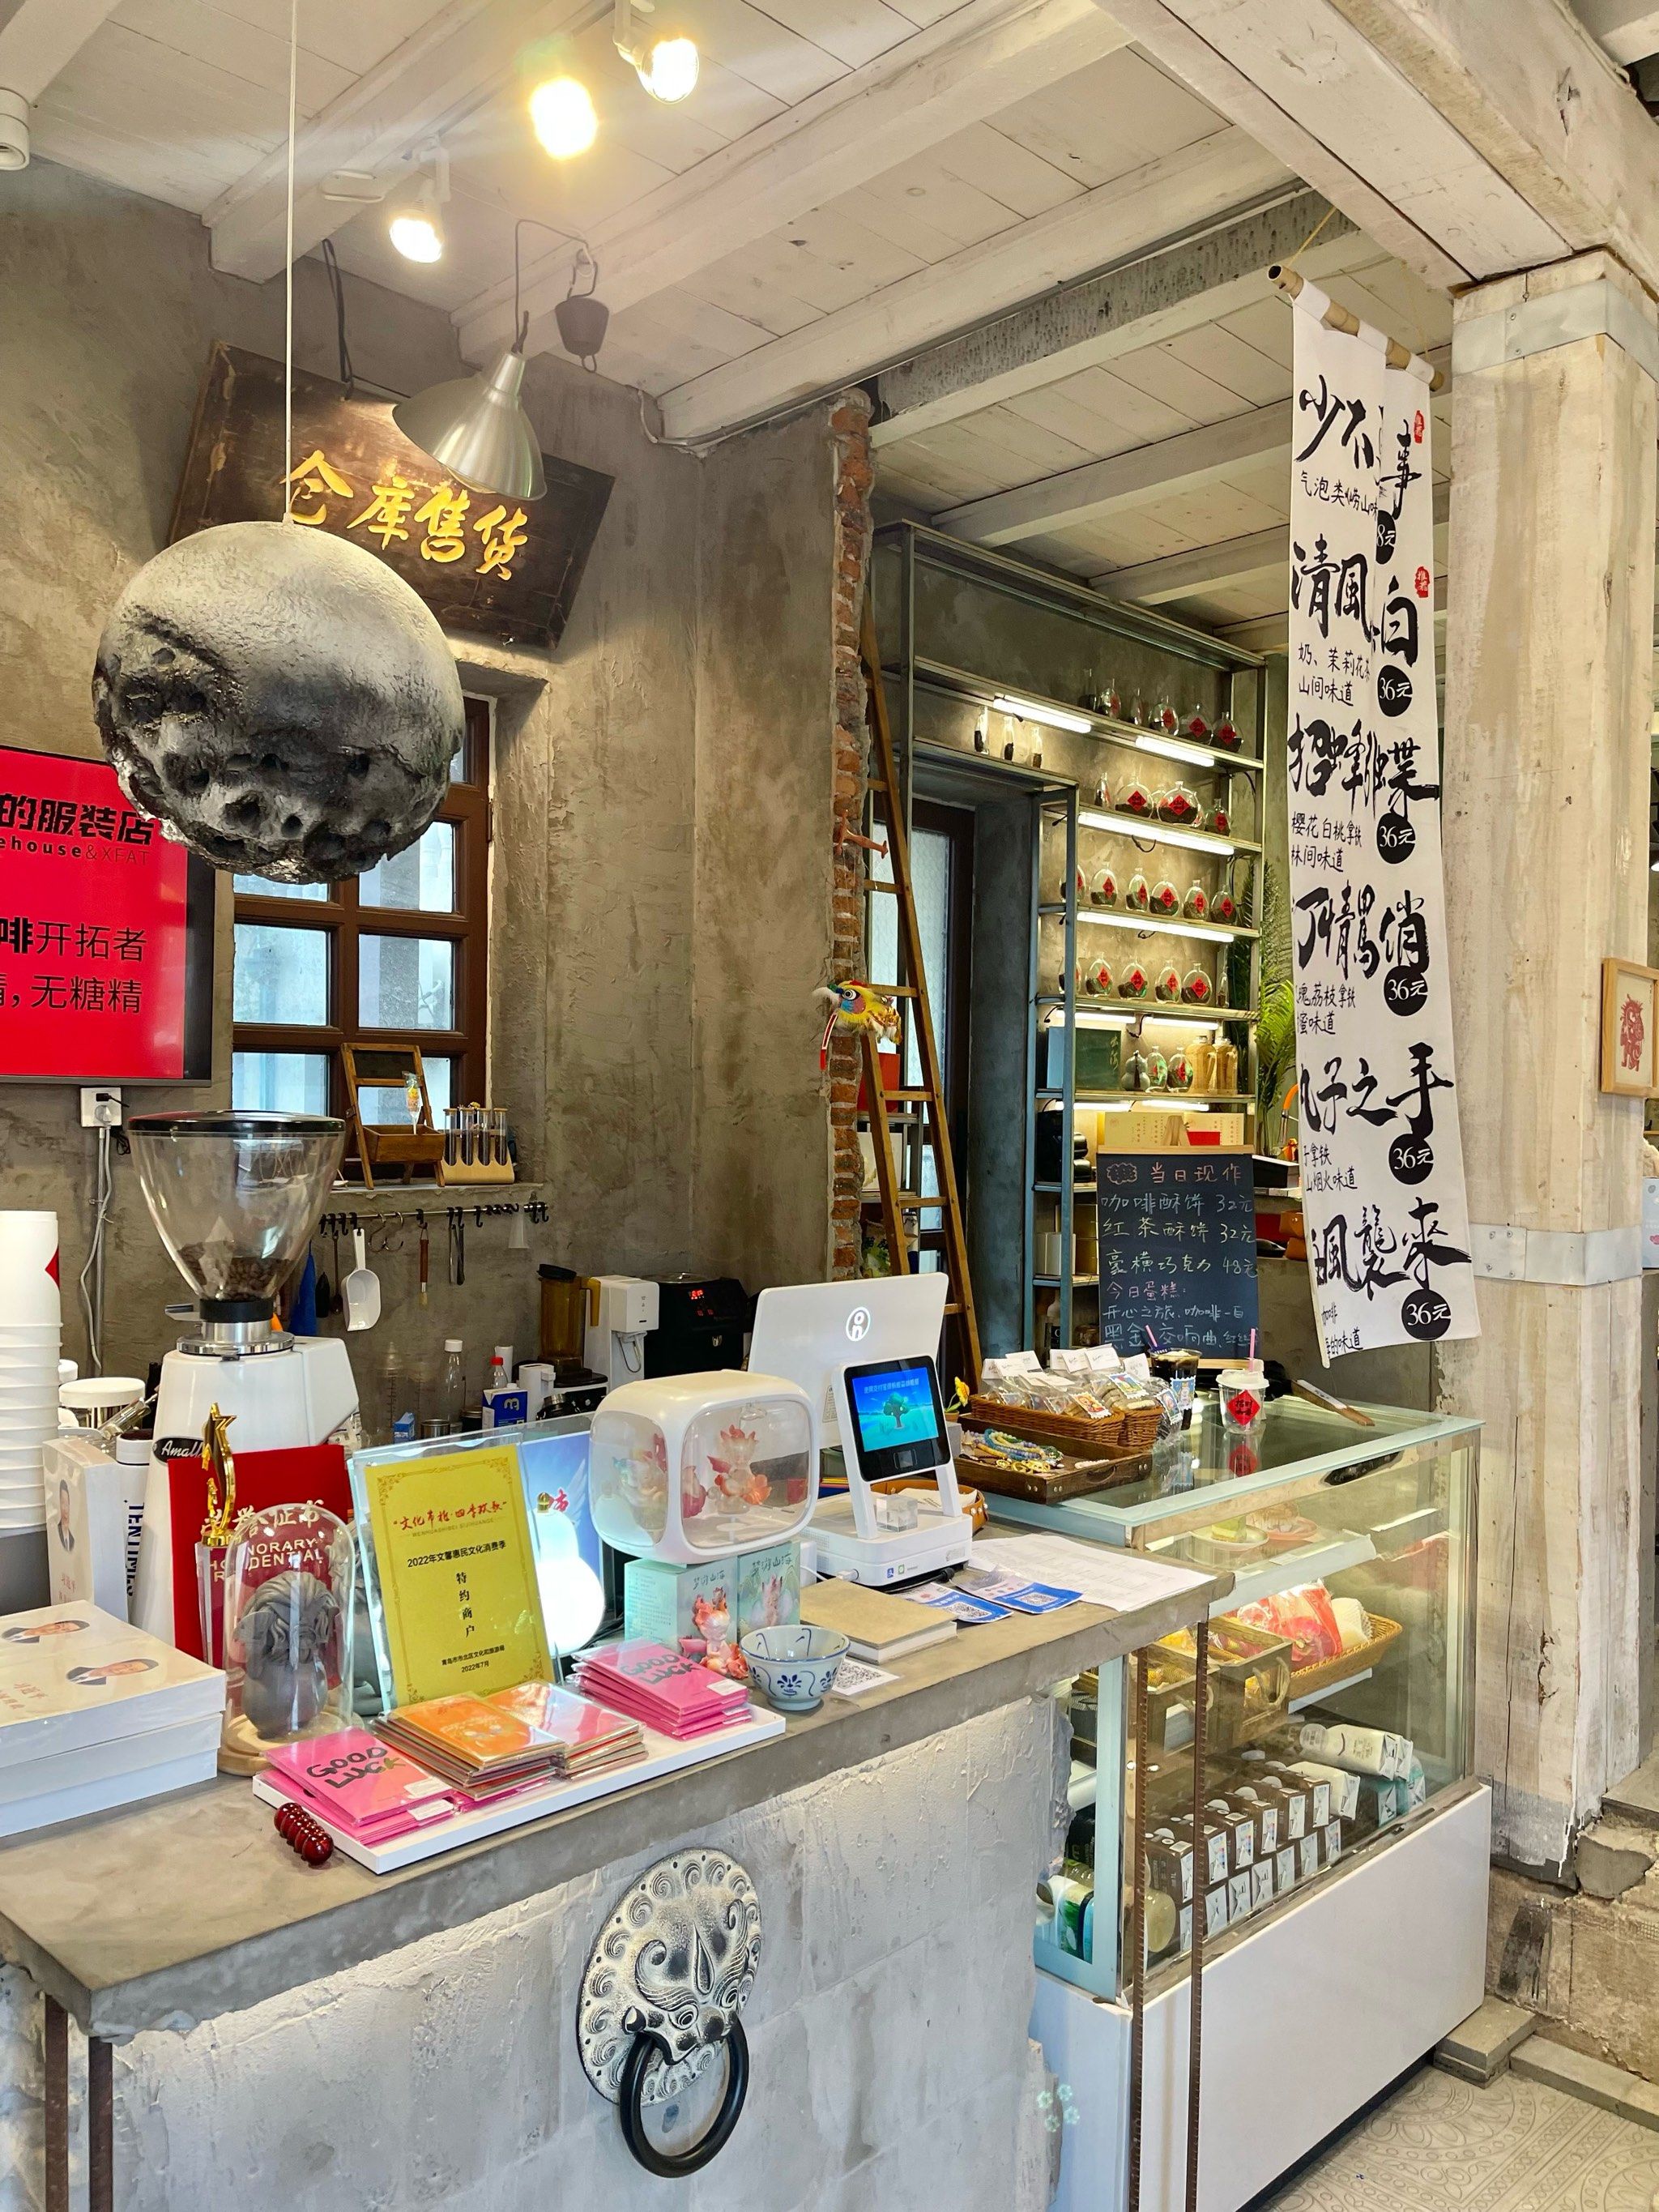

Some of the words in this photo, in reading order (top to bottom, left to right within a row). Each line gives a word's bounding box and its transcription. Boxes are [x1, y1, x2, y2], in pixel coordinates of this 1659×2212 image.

[279, 449, 528, 581] 仓库售货
[1299, 676, 1354, 707] 山间味道
[1379, 677, 1413, 702] 36元
[1379, 825, 1415, 848] 36元
[1387, 976, 1428, 1001] 36元
[1392, 1147, 1434, 1170] 36元
[1150, 1162, 1243, 1186] 当日现作
[1101, 1193, 1205, 1216] 咖啡酥饼
[1215, 1194, 1253, 1213] 32元
[1102, 1218, 1209, 1243] 红茶酥饼
[1220, 1223, 1256, 1244] 32元
[1106, 1249, 1211, 1276] 豪横巧克力
[1222, 1256, 1258, 1278] 48元
[1407, 1303, 1450, 1326] 36元
[306, 1747, 388, 1778] GOOD
[325, 1757, 406, 1789] LUCK
